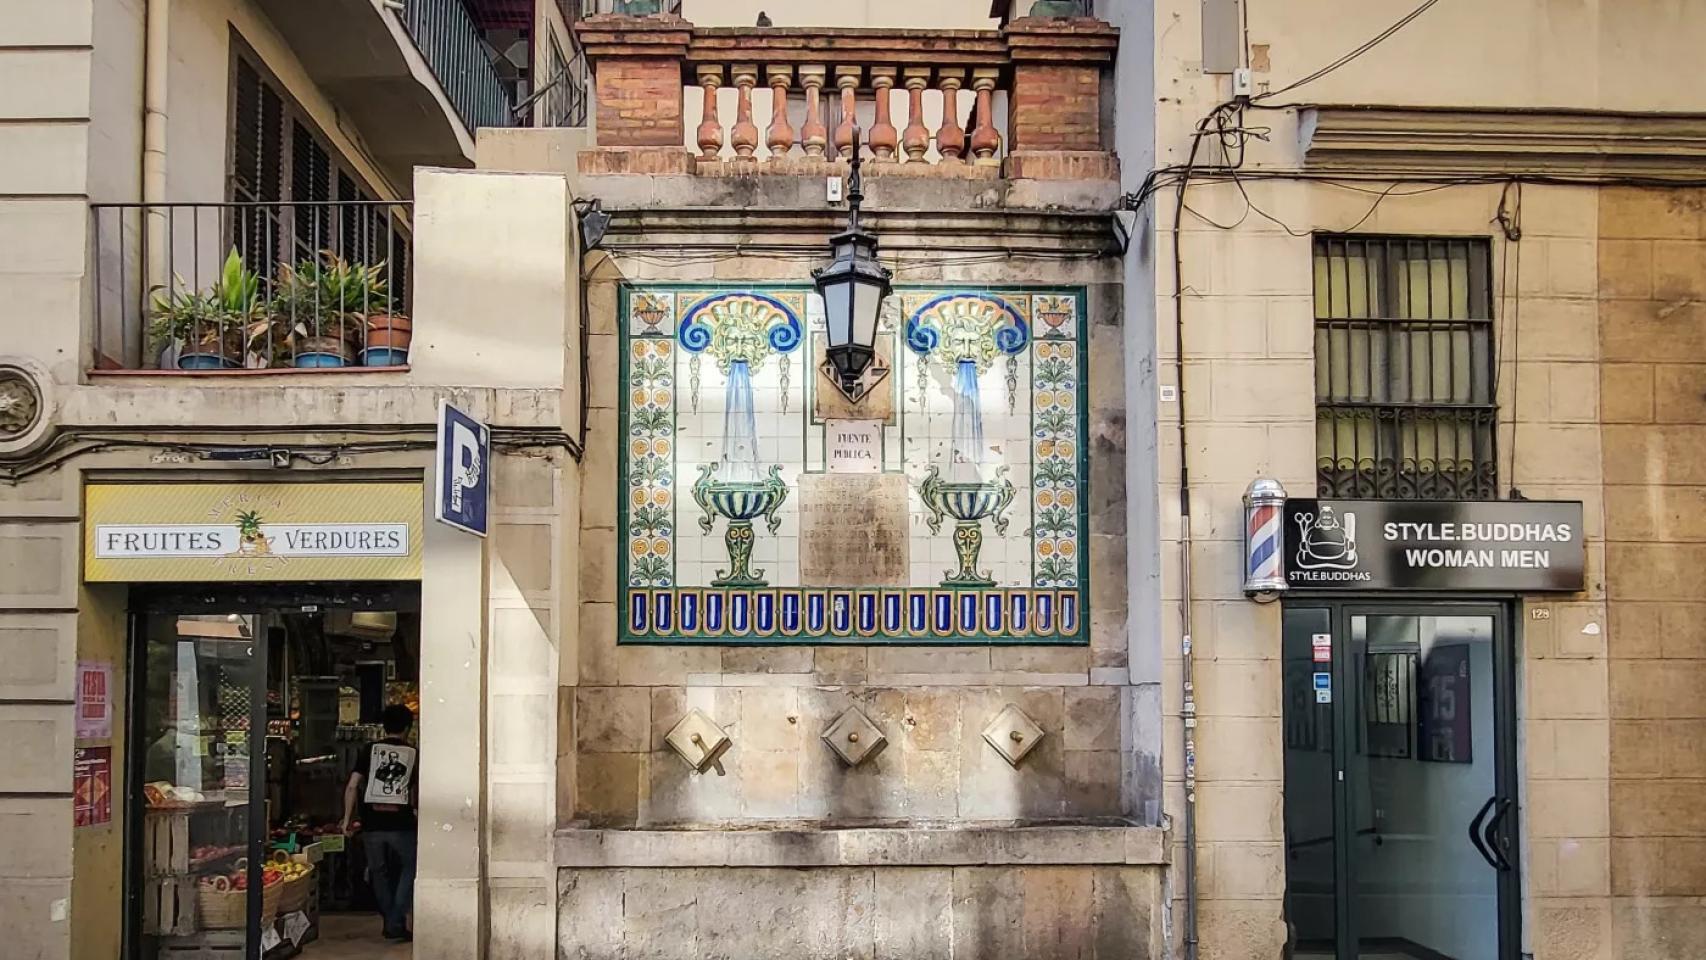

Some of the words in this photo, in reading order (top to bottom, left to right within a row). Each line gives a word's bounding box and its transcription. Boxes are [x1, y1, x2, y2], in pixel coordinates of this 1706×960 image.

[837, 433, 872, 443] FUENTE
[452, 421, 481, 514] P
[107, 532, 222, 551] FRUITES
[285, 528, 401, 550] VERDURES
[1383, 522, 1573, 542] STYLE.BUDDHAS
[1405, 549, 1495, 568] WOMAN
[1500, 550, 1551, 568] MEN
